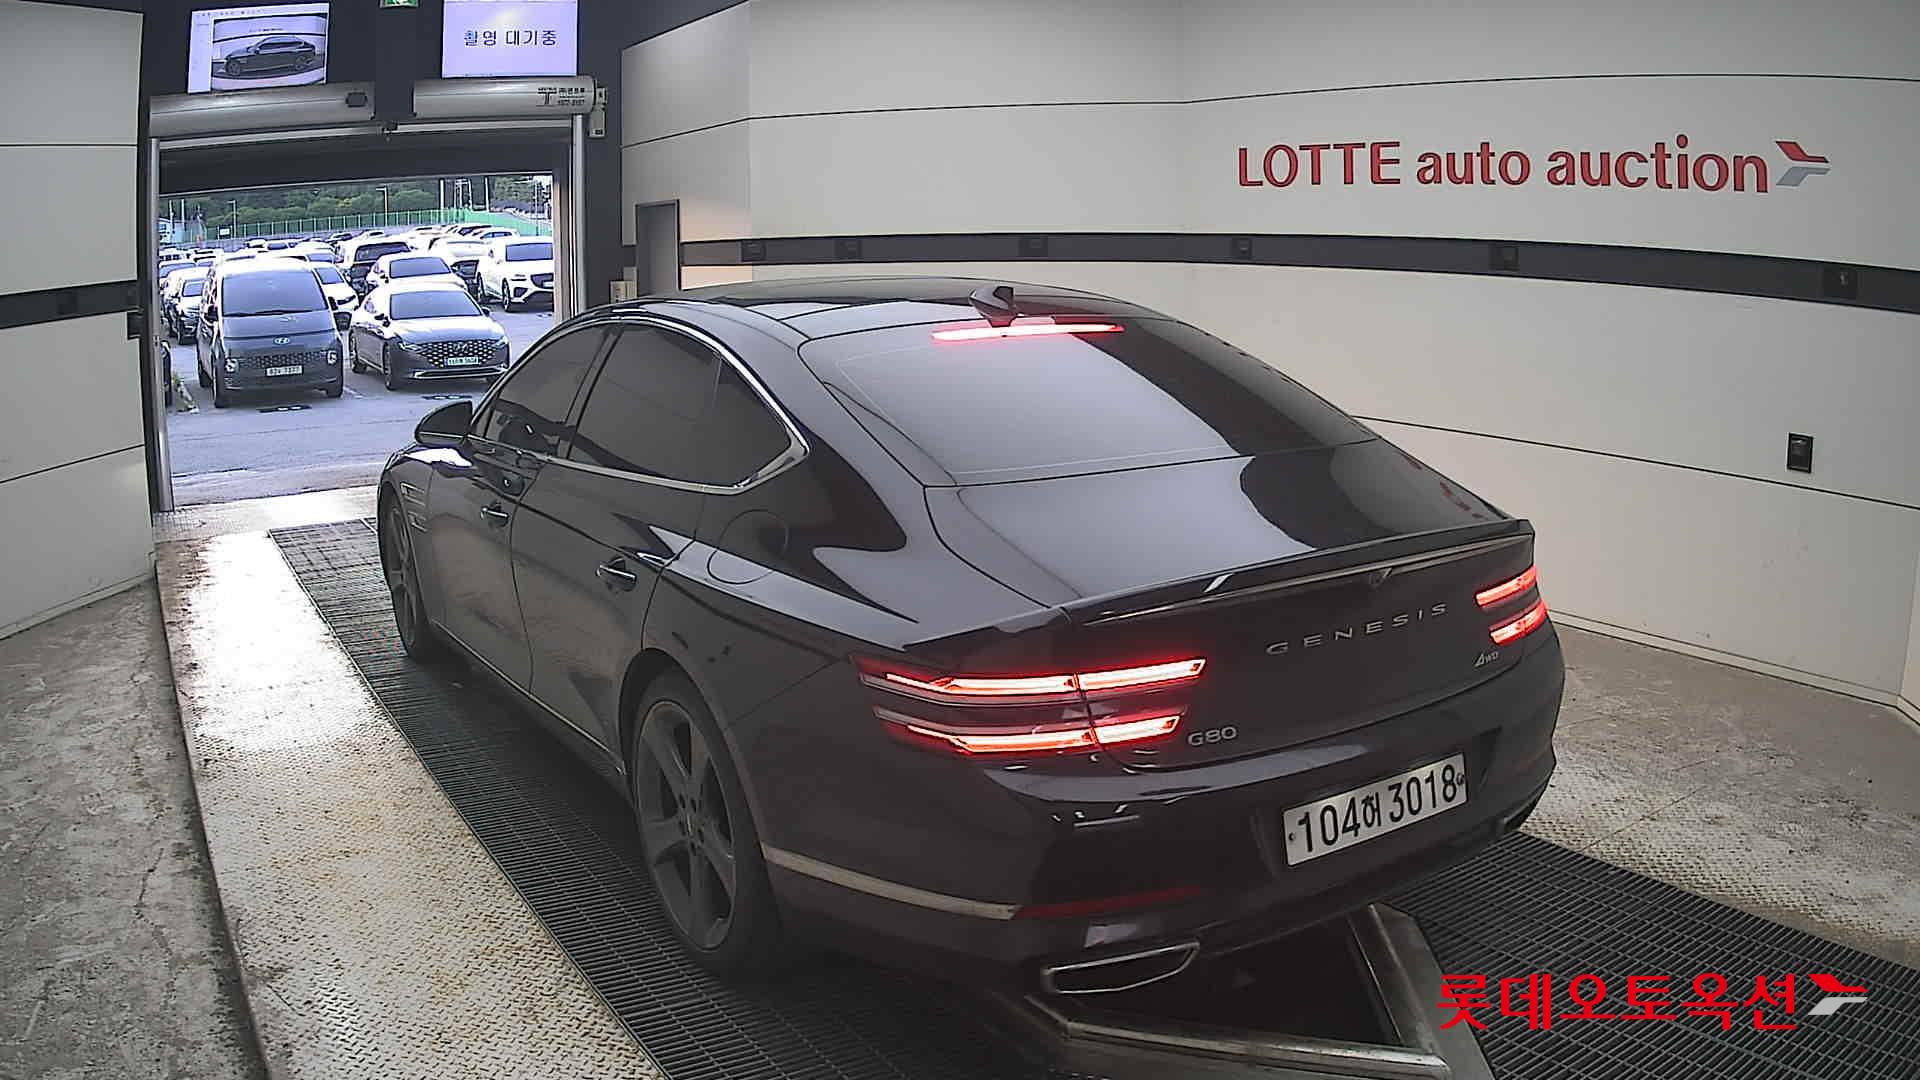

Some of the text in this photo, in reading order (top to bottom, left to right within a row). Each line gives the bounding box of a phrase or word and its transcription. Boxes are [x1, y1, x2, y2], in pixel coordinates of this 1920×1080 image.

[505, 30, 557, 47] 대기중
[1238, 134, 1768, 193] LOTTE auto auction
[1266, 602, 1447, 655] GENESIS
[1188, 726, 1237, 746] G80
